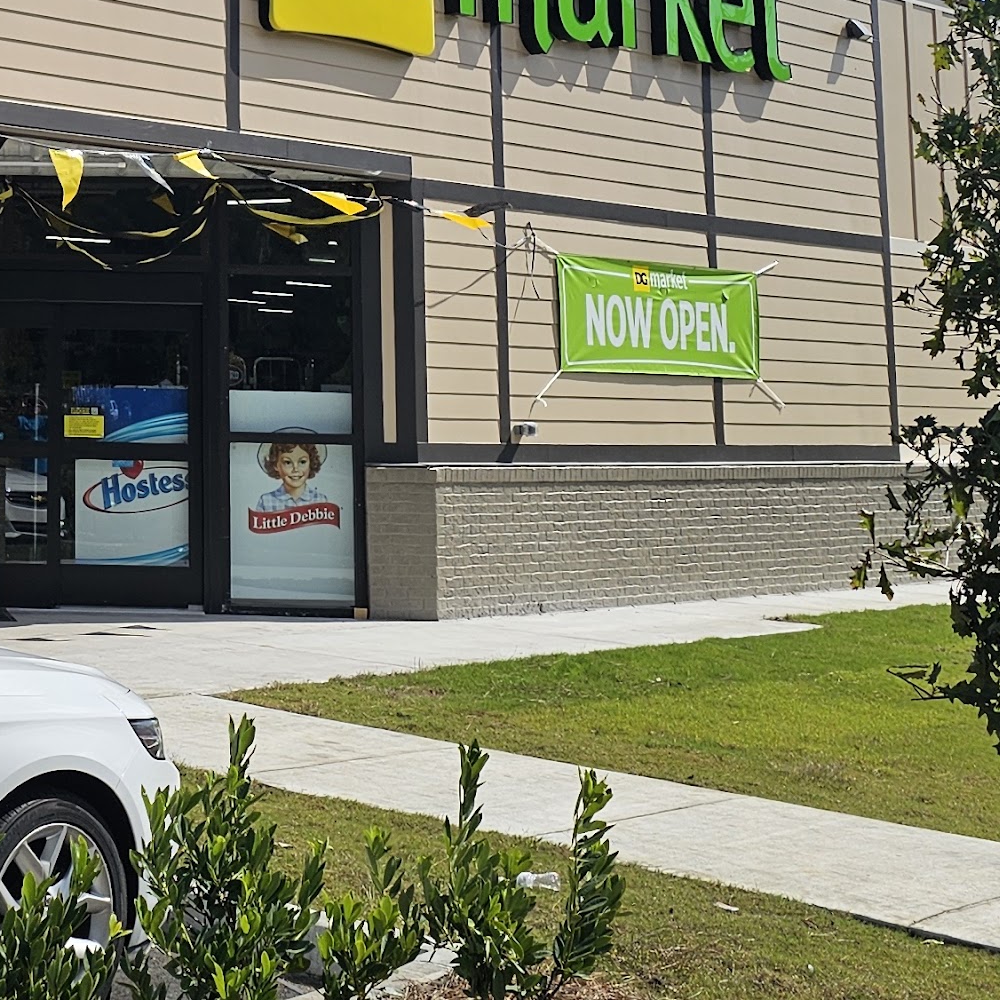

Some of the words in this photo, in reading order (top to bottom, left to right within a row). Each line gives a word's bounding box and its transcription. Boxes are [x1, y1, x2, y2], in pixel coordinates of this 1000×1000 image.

[634, 271, 648, 286] DG
[650, 269, 688, 290] market
[585, 293, 653, 349] NOW
[659, 298, 736, 353] OPEN.
[252, 515, 287, 530] Little
[290, 507, 335, 526] Debbie
